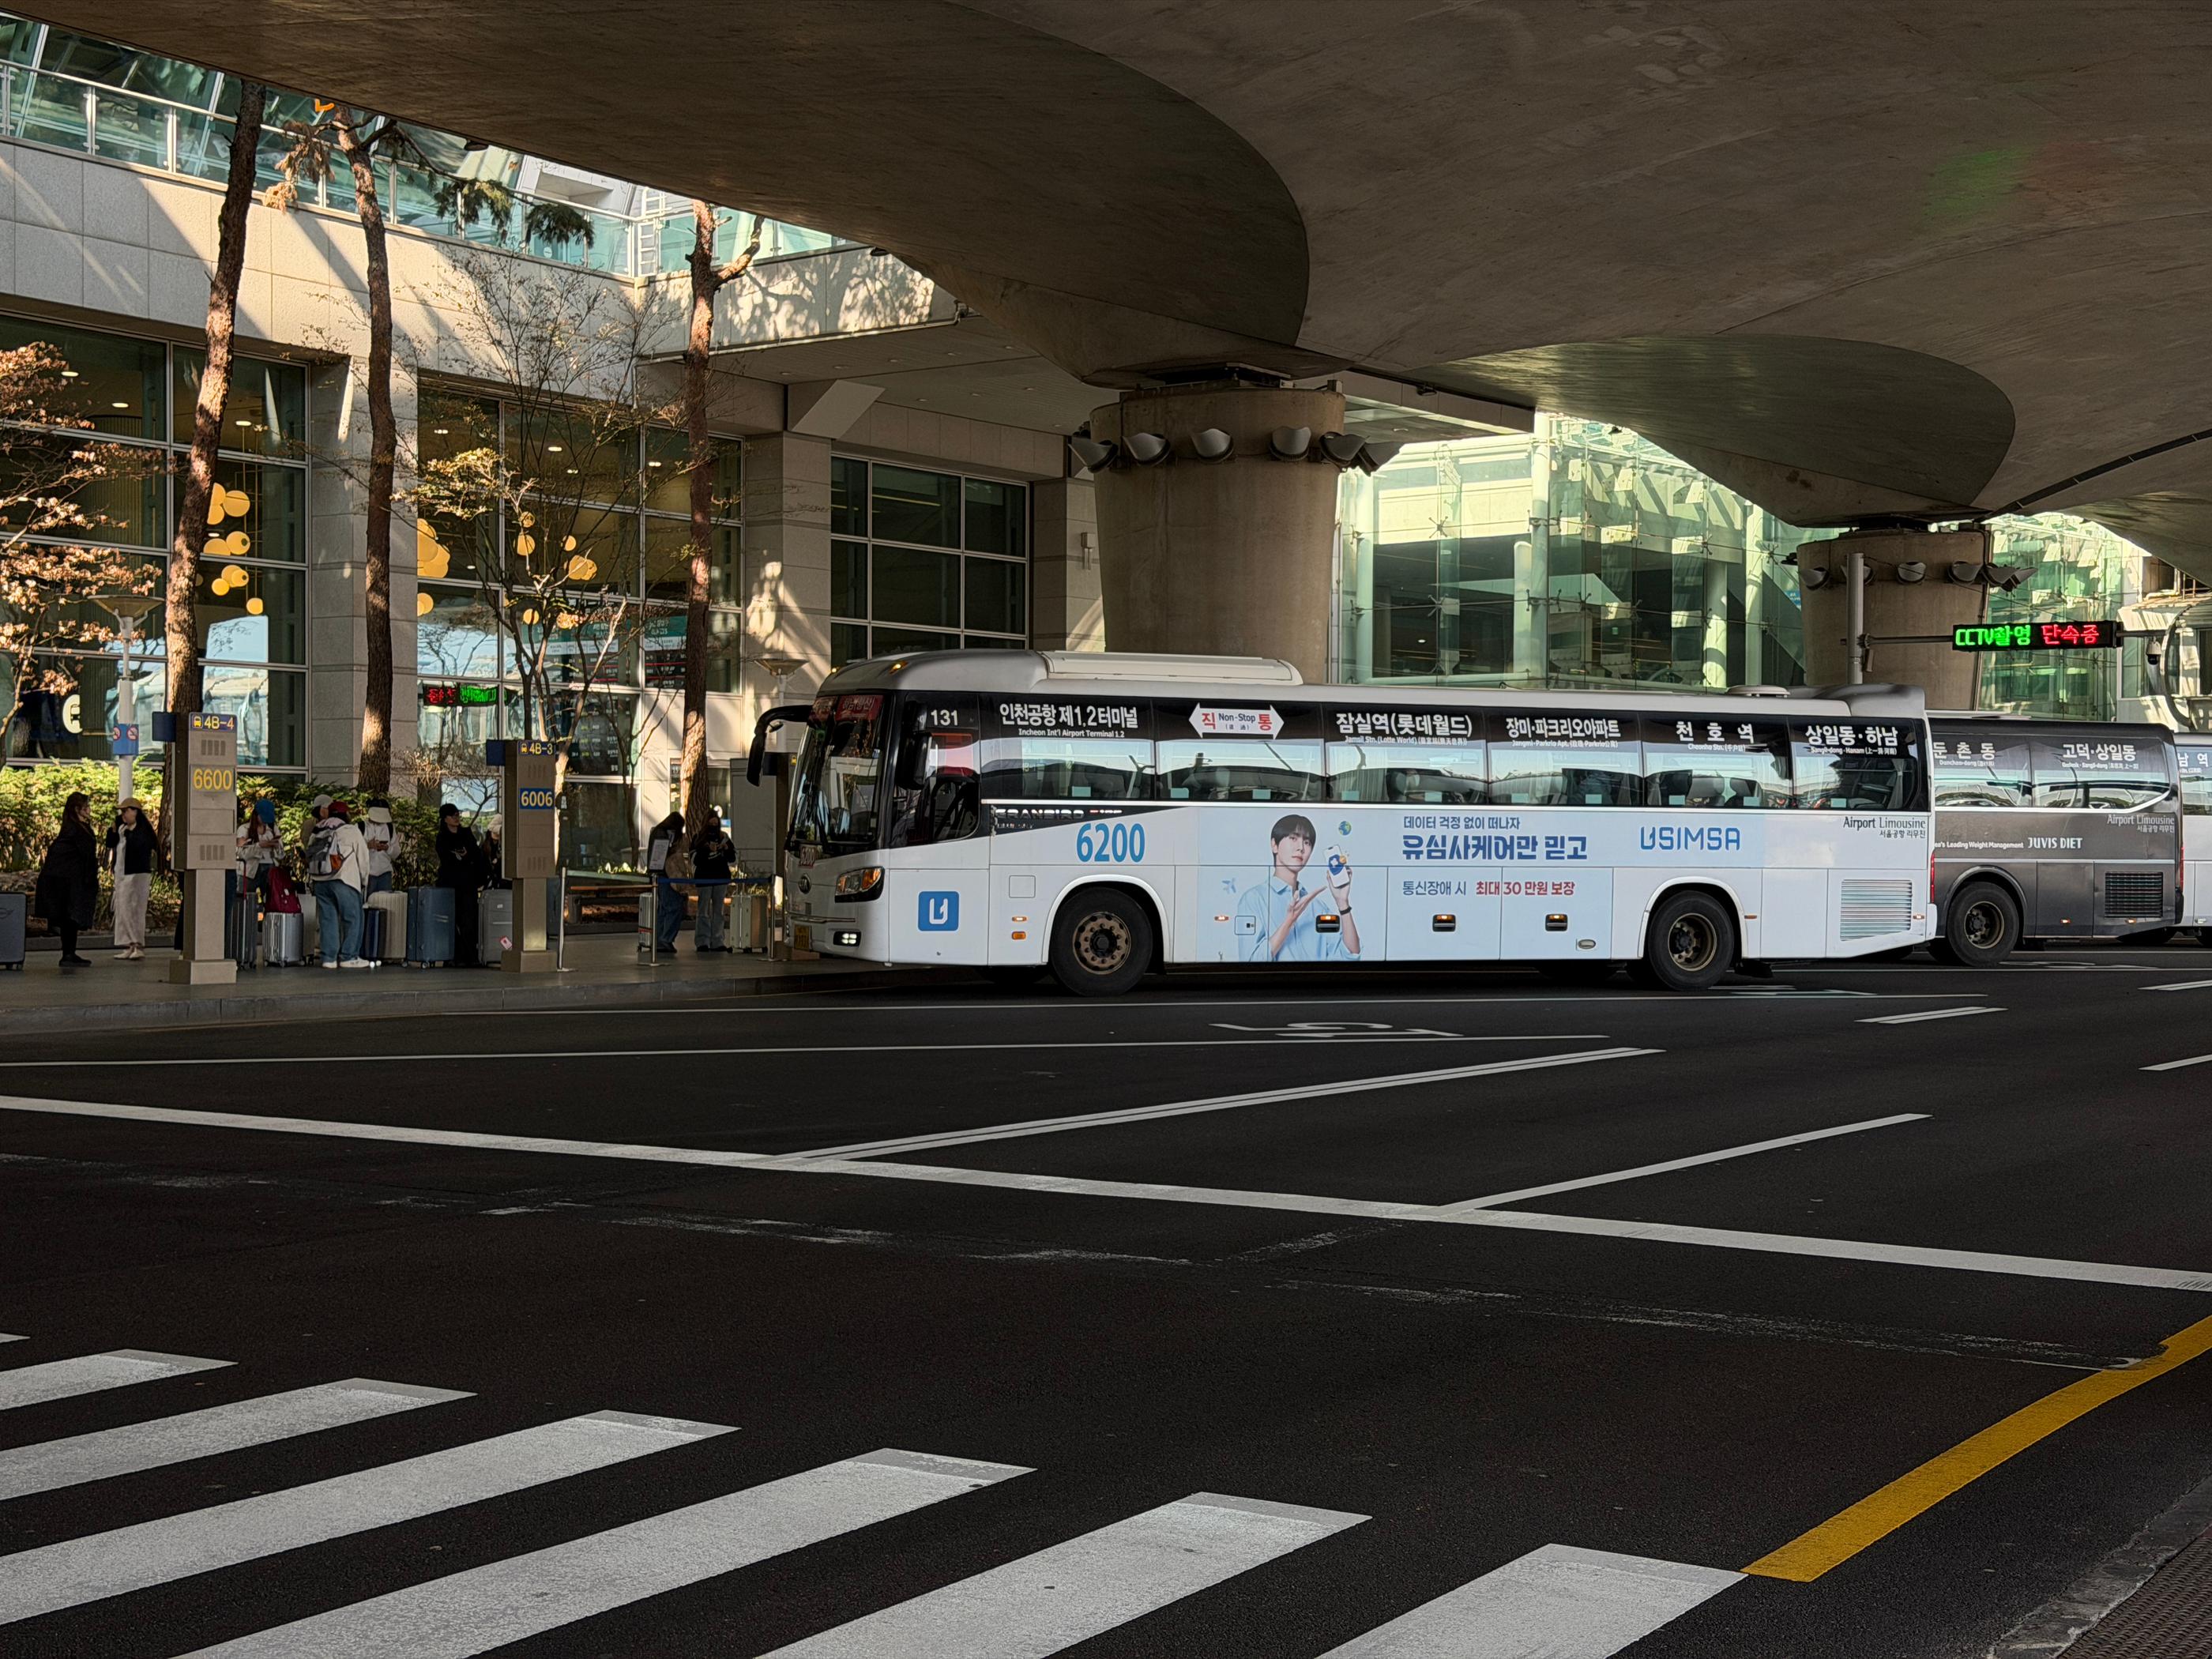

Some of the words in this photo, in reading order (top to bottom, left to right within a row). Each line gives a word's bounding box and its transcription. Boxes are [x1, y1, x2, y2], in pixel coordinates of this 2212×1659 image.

[1955, 624, 2031, 646] CCTV촬영
[204, 715, 235, 730] 4B-4
[931, 709, 958, 726] 131
[999, 703, 1056, 727] 인천공항
[1201, 712, 1216, 730] 직
[1218, 713, 1256, 724] Non-Stop
[1258, 713, 1273, 731] 통
[1062, 729, 1085, 738] Airport
[1336, 713, 1473, 737] 잠실역(롯데월드)
[1506, 717, 1621, 739] 장미·파크리오아파트
[529, 742, 553, 755] 4B-3
[194, 768, 232, 790] 6600
[521, 791, 553, 807] 6006
[1404, 816, 1436, 829] 데이터
[1439, 816, 1461, 830] 걱정
[1464, 817, 1485, 830] 없이
[1488, 817, 1521, 830] 떠나자
[1843, 816, 1876, 831] Airport
[1879, 817, 1926, 829] Limousine
[2107, 814, 2135, 826] Airport
[2136, 814, 2175, 825] Limousine
[1076, 822, 1146, 863] 6200
[1402, 834, 1538, 860] 유심사케어만
[1544, 835, 1588, 860] 믿고
[1640, 826, 1740, 851] USIMSA
[2027, 837, 2057, 848] JUVIS
[2060, 838, 2083, 848] DIET
[1403, 881, 1451, 896] 통신장애
[1454, 881, 1466, 896] 시
[1476, 881, 1500, 896] 최대
[1503, 882, 1522, 895] 30
[1525, 881, 1548, 896] 만원
[1551, 881, 1575, 896] 보장
